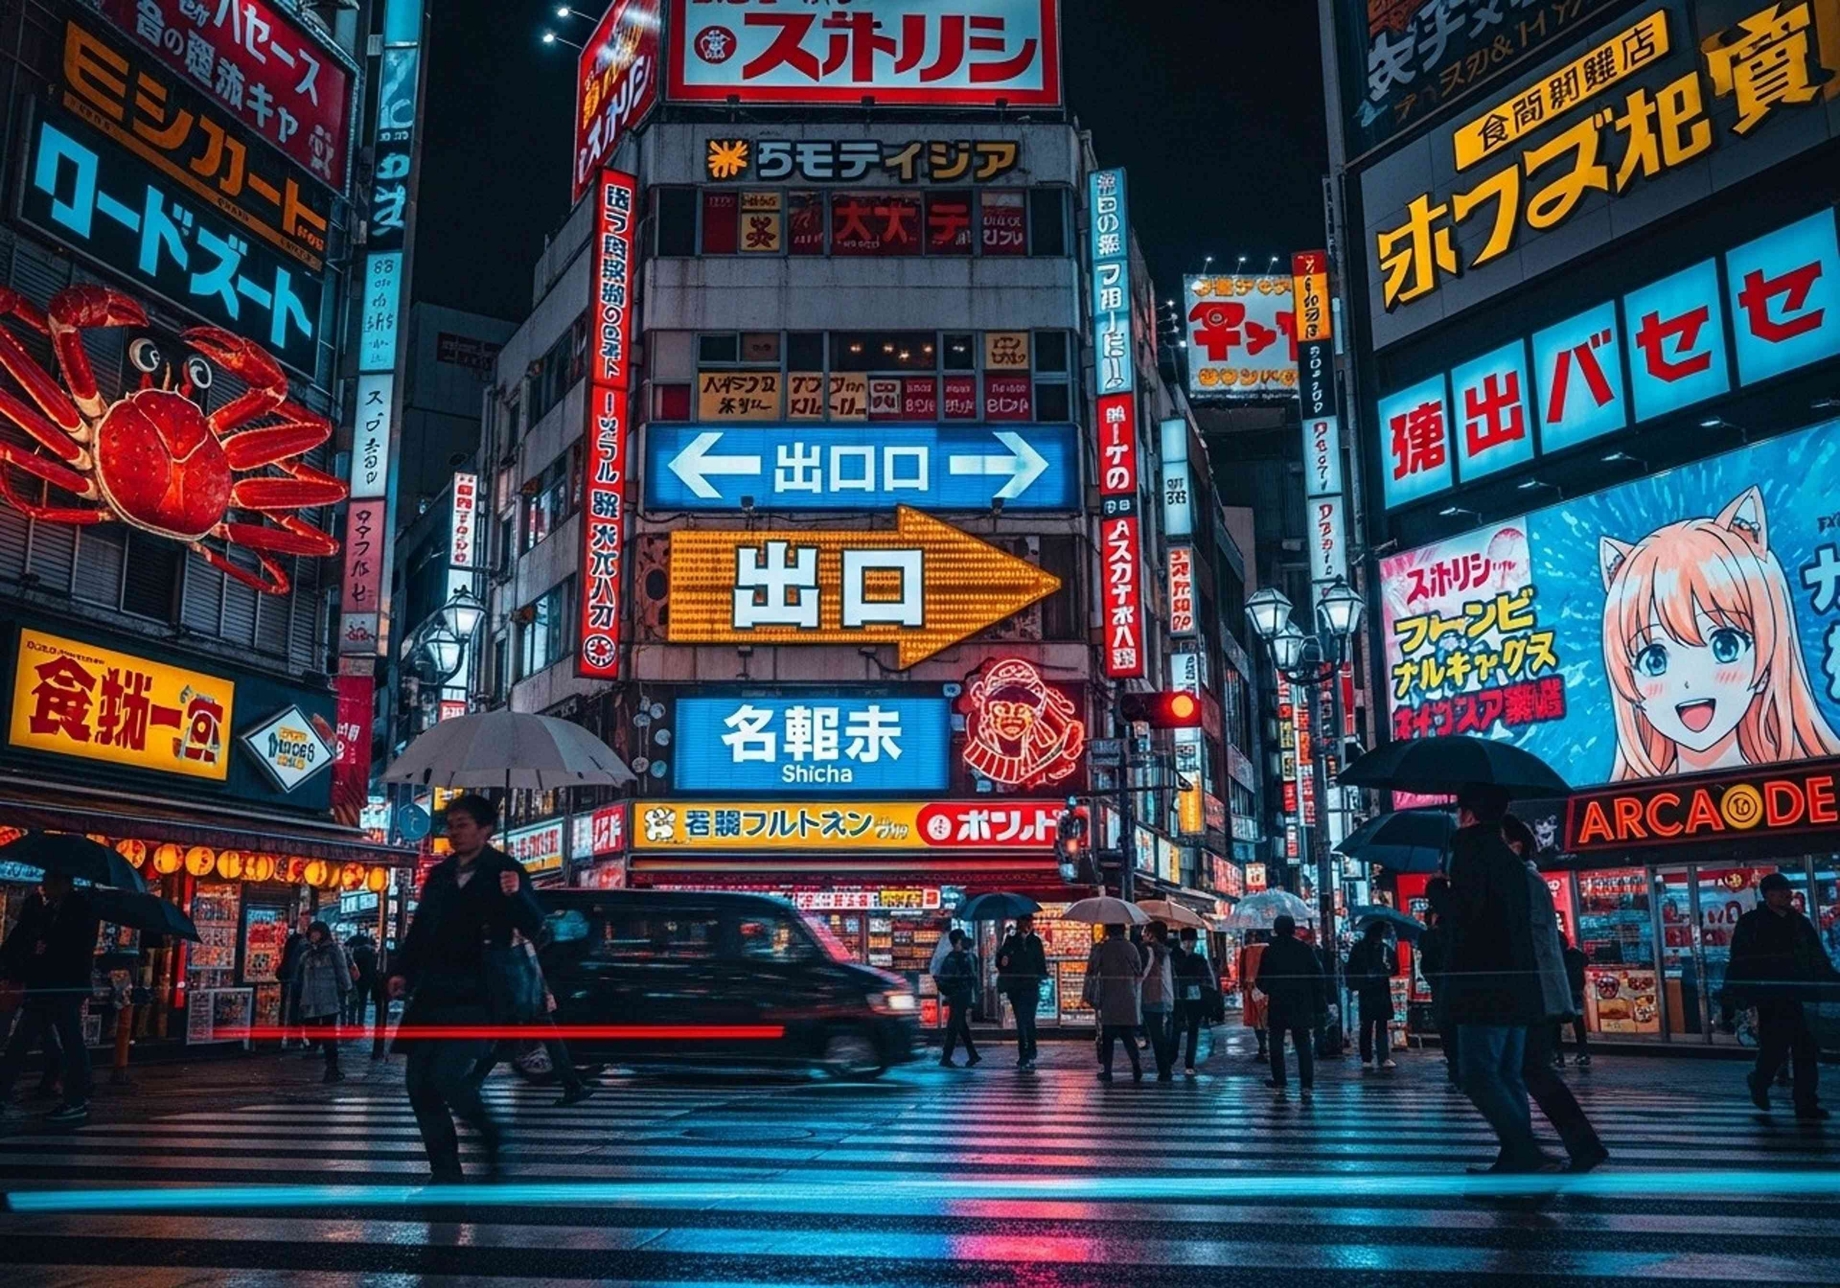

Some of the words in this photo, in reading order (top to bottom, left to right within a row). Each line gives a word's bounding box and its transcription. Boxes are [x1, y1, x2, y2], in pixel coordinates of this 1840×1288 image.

[774, 442, 930, 494] 出口口
[732, 541, 924, 628] 出口
[782, 764, 853, 783] Shicha
